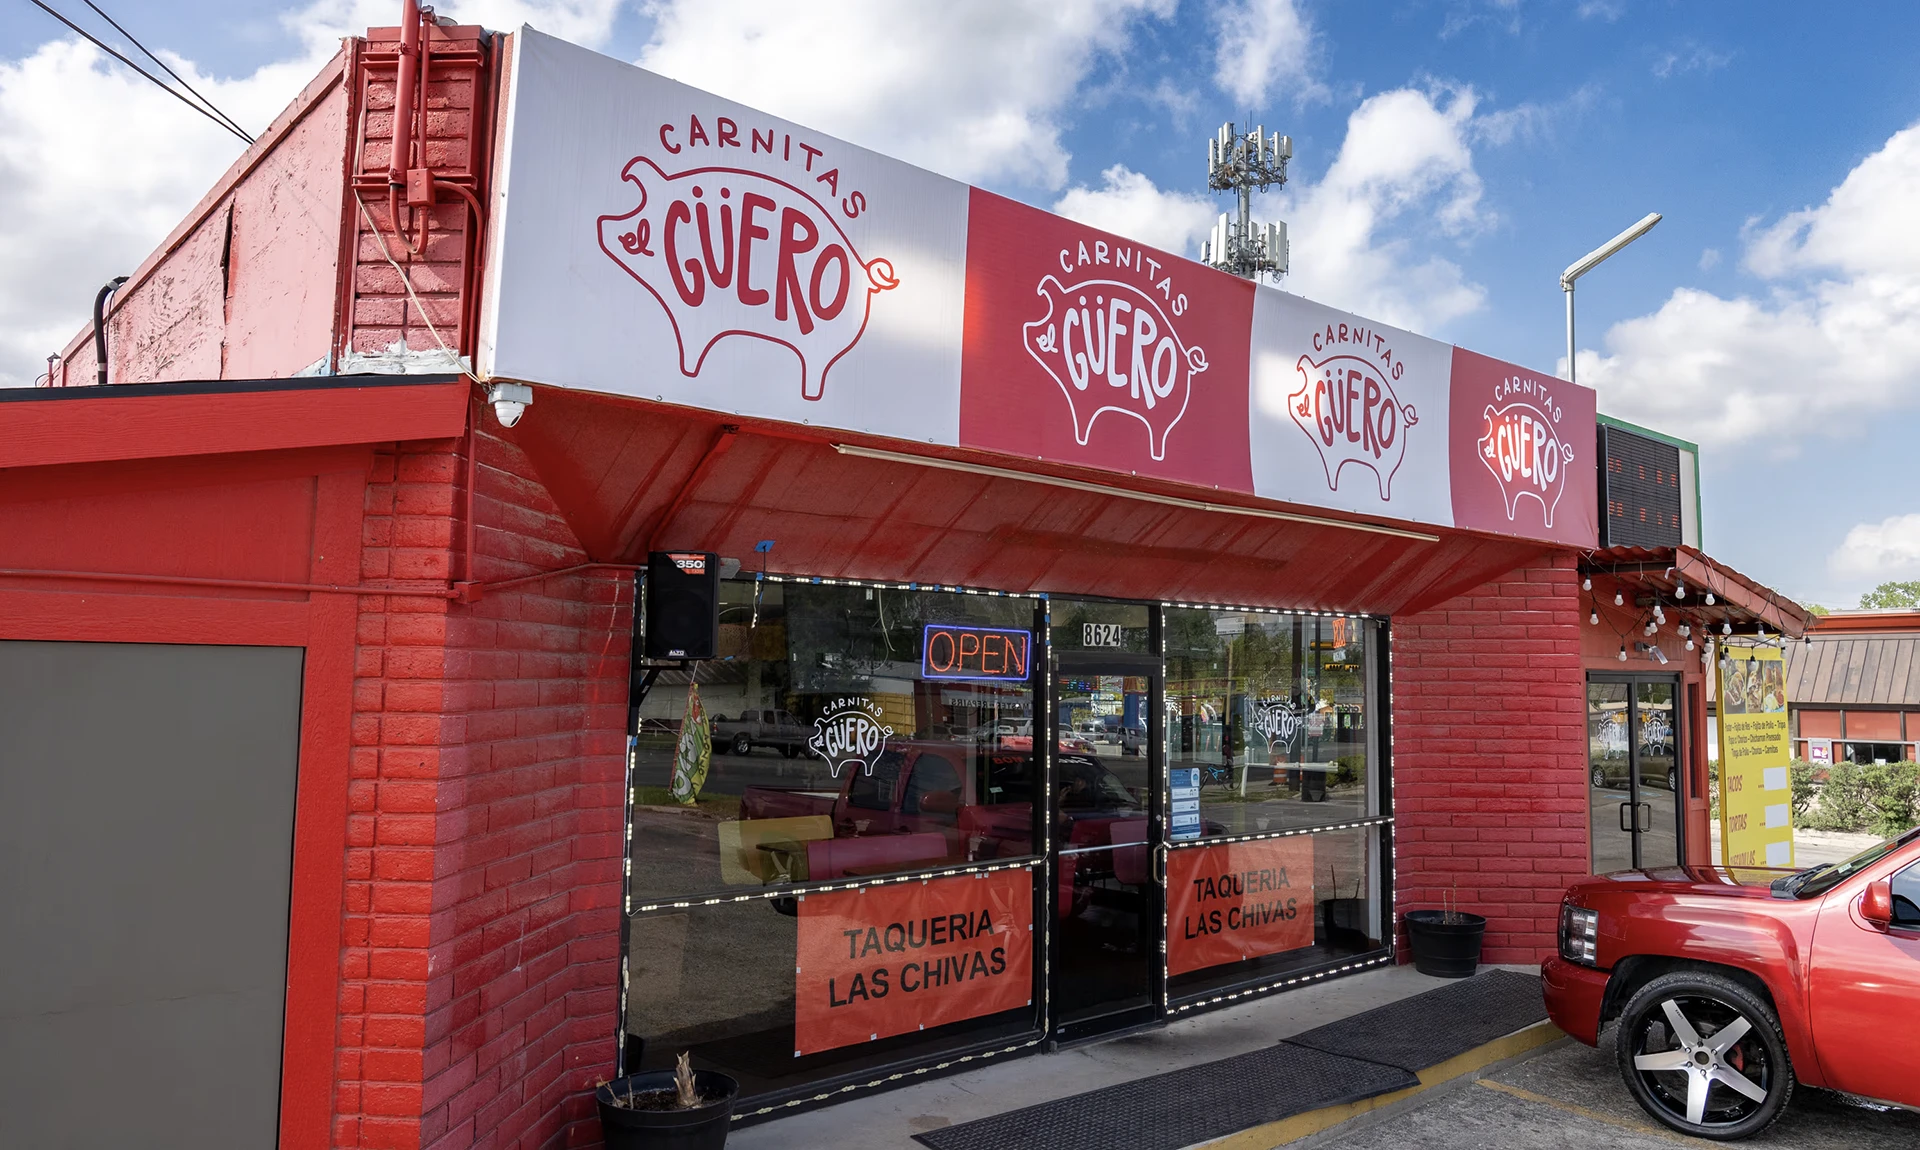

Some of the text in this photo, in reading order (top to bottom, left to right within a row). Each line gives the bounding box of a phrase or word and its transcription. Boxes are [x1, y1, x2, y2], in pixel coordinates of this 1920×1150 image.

[660, 114, 866, 218] CARNITAS
[618, 185, 850, 335] el GÜERO
[1059, 240, 1188, 316] CARNITAS
[1036, 295, 1177, 409] el GÜERO
[1313, 323, 1404, 380] CARNITAS
[1297, 368, 1396, 459] el GÜERO
[1495, 375, 1562, 423] CARNITAS
[1484, 437, 1496, 458] el
[1498, 415, 1558, 491] GÜERO
[676, 560, 703, 569] 350
[928, 631, 1026, 675] OPEN
[1084, 624, 1120, 646] 8624
[823, 697, 883, 717] CARNITAS
[1264, 709, 1295, 739] GÜERO
[814, 717, 879, 757] el GÜERO
[1727, 774, 1743, 793] TACOS
[1729, 813, 1748, 833] TORTAS
[1194, 866, 1291, 903] TAQUERIA
[843, 909, 994, 959] TAQUERIA
[1185, 897, 1298, 940] LAS CHIVAS
[829, 947, 1006, 1008] LAS CHIVAS
